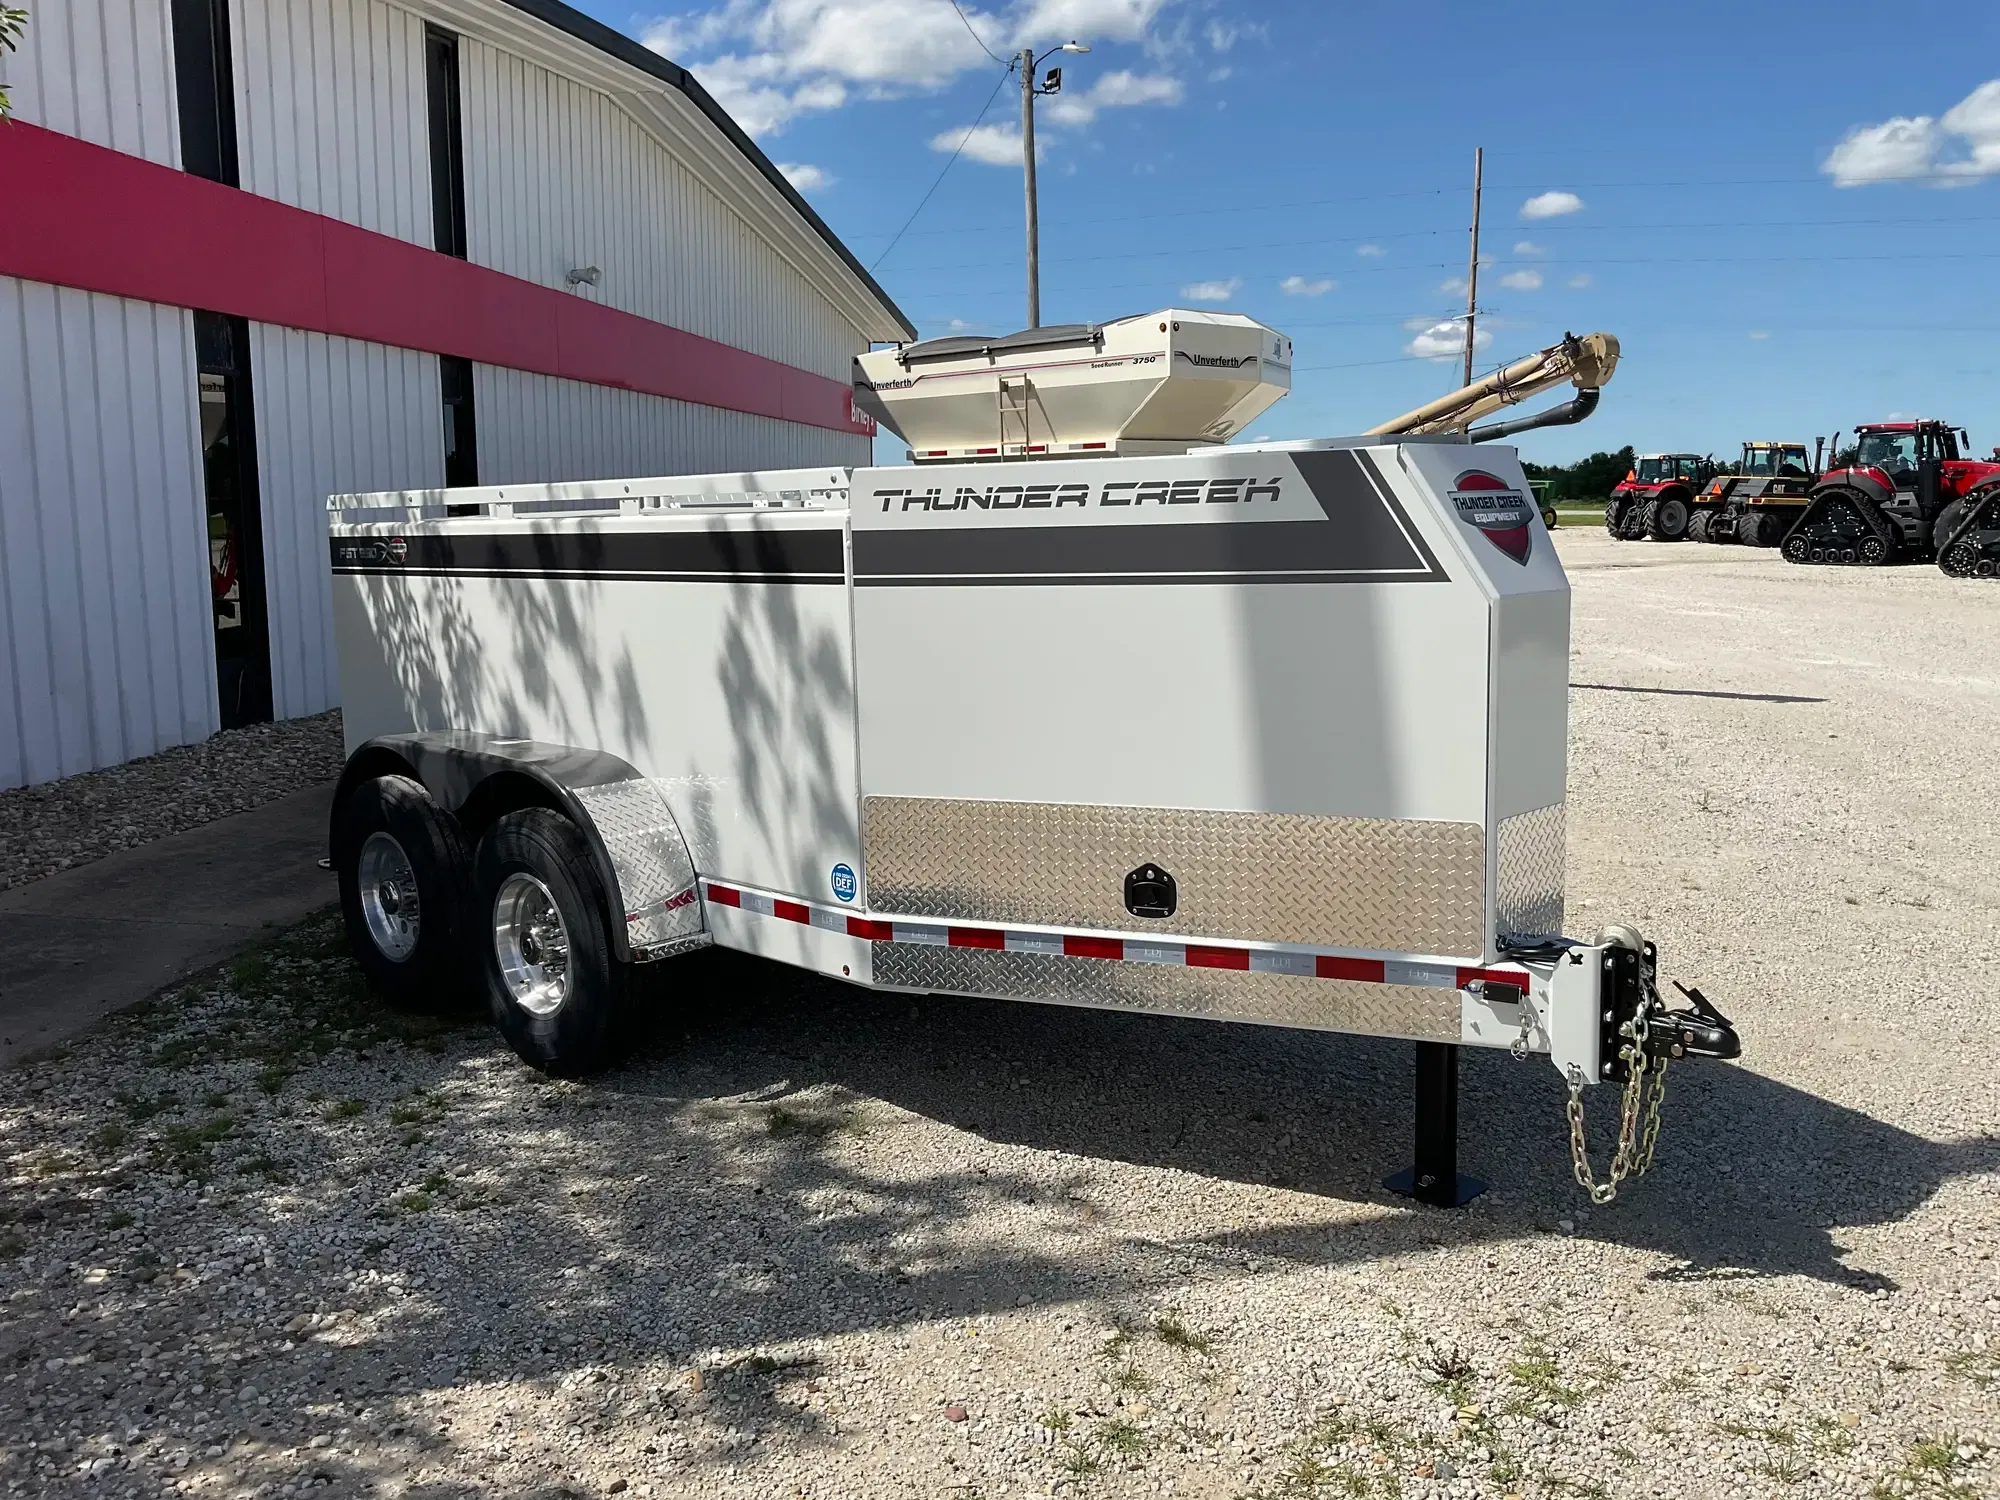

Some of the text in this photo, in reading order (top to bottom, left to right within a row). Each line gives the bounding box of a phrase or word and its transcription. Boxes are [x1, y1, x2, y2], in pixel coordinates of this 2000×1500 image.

[1132, 356, 1156, 364] 3750
[1193, 354, 1239, 367] Unverferth
[870, 378, 912, 390] Unverferth
[873, 477, 1283, 512] THUNDER CREEK
[1773, 484, 1786, 494] CAT
[1453, 495, 1526, 510] THUNDER CREEK
[1474, 512, 1520, 523] EQUIPMENT
[835, 876, 852, 889] DEF
